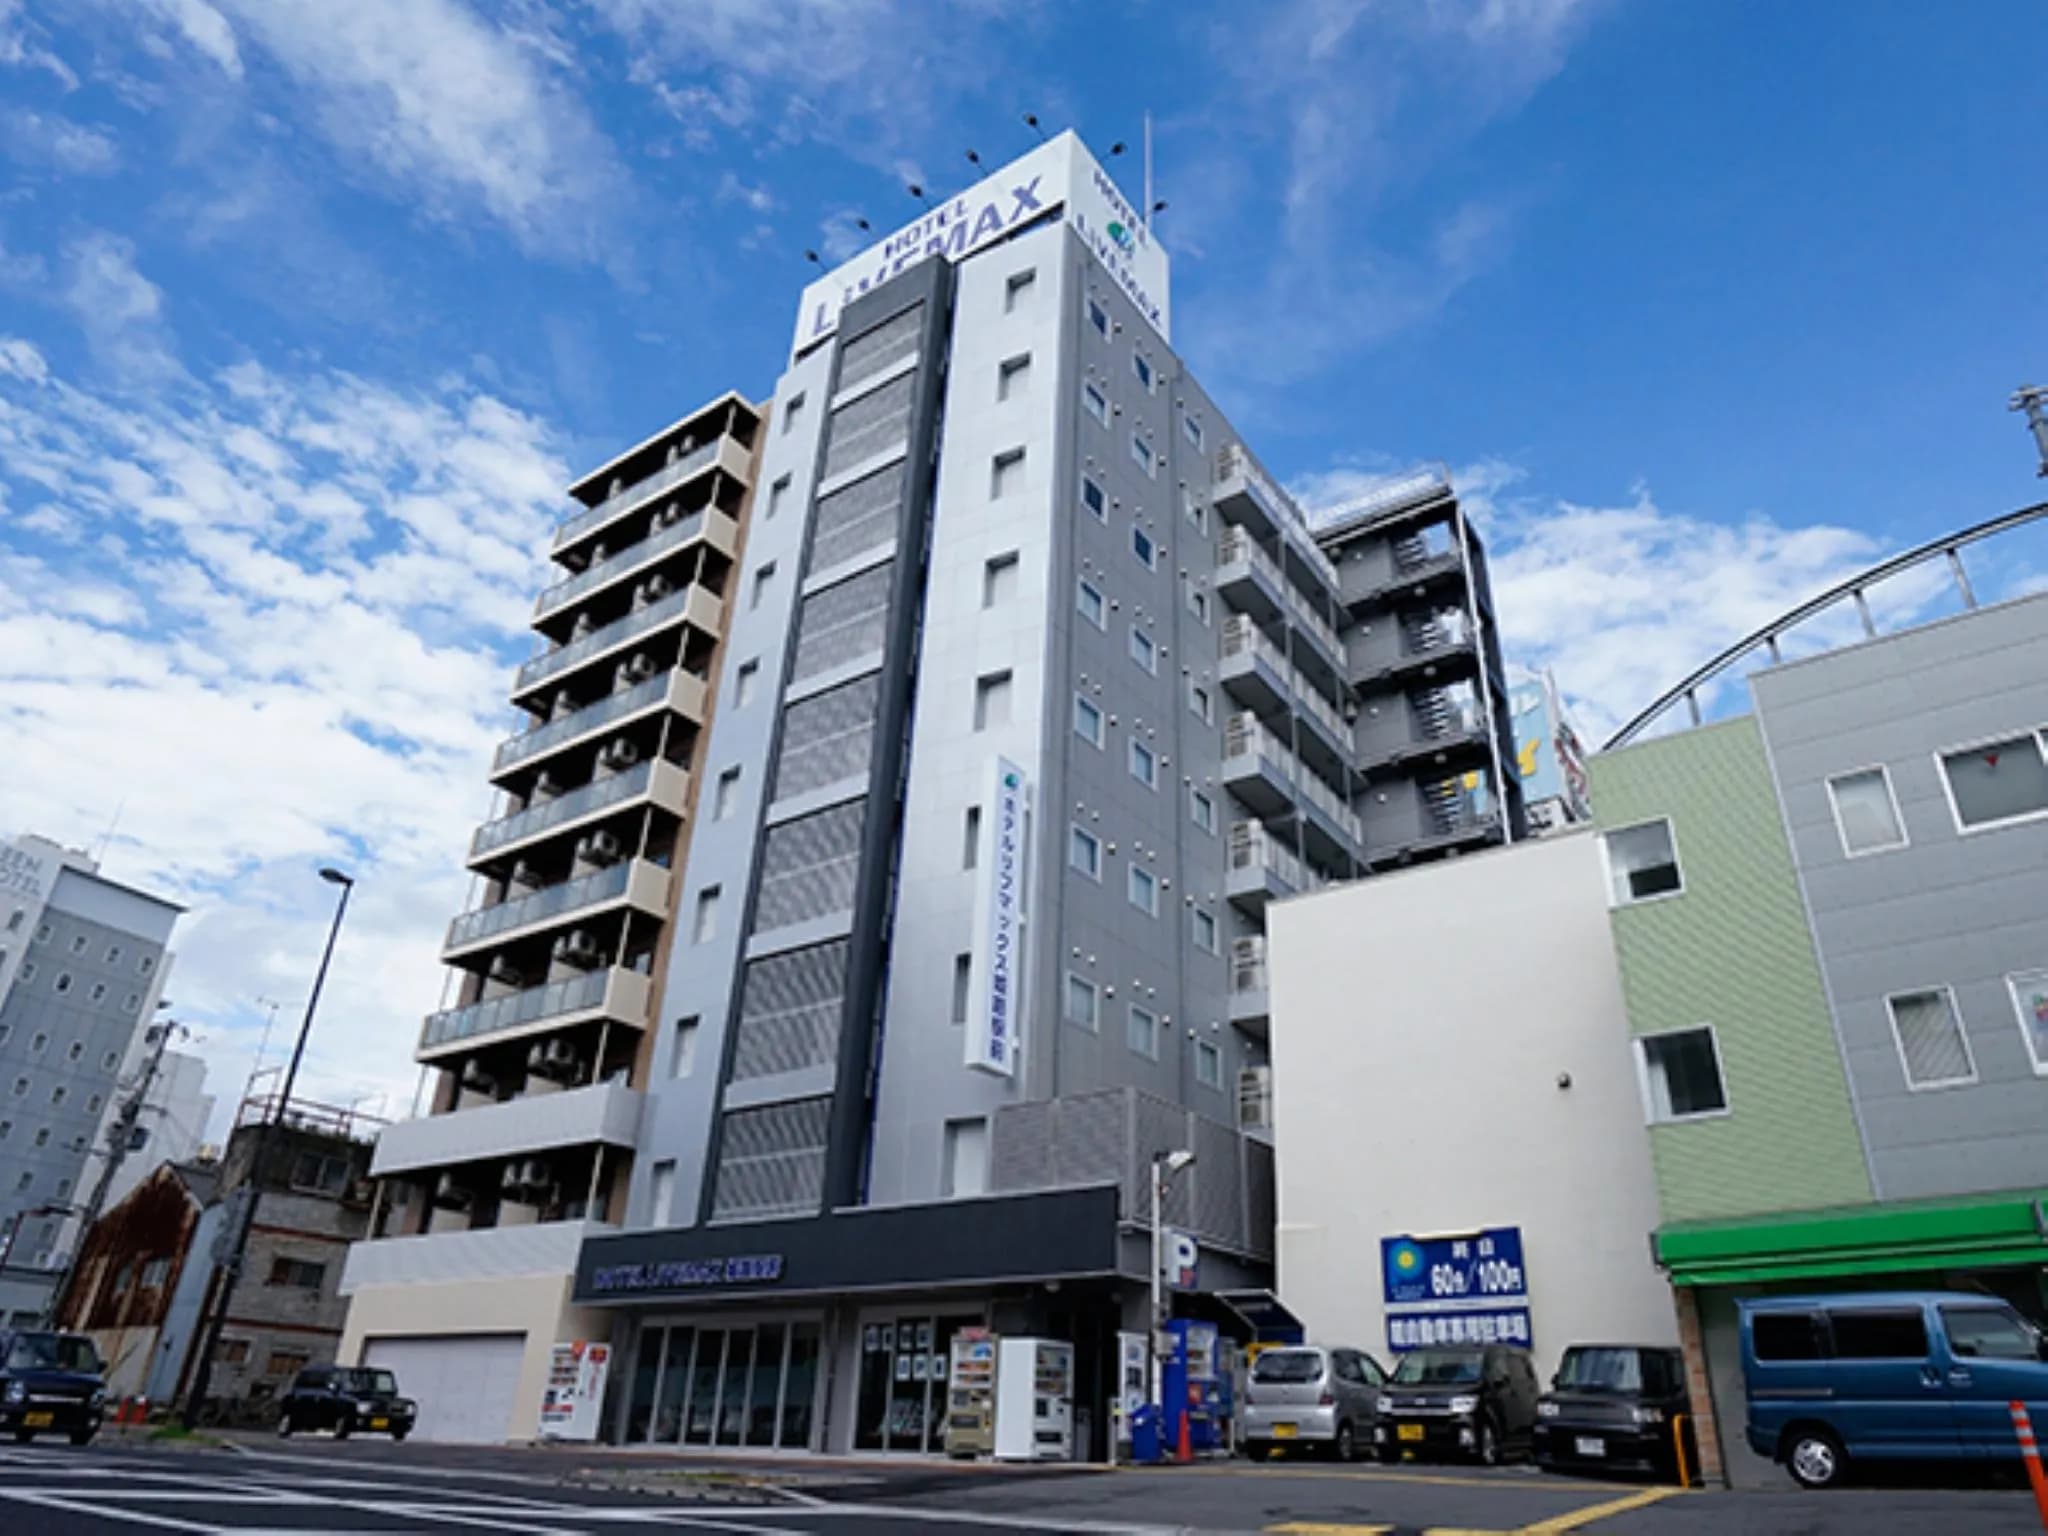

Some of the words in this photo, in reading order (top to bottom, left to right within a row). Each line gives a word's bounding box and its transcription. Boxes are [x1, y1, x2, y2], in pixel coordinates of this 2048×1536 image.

[884, 199, 969, 259] HOTEL
[1093, 167, 1148, 248] HOTEL
[1168, 1232, 1198, 1286] P
